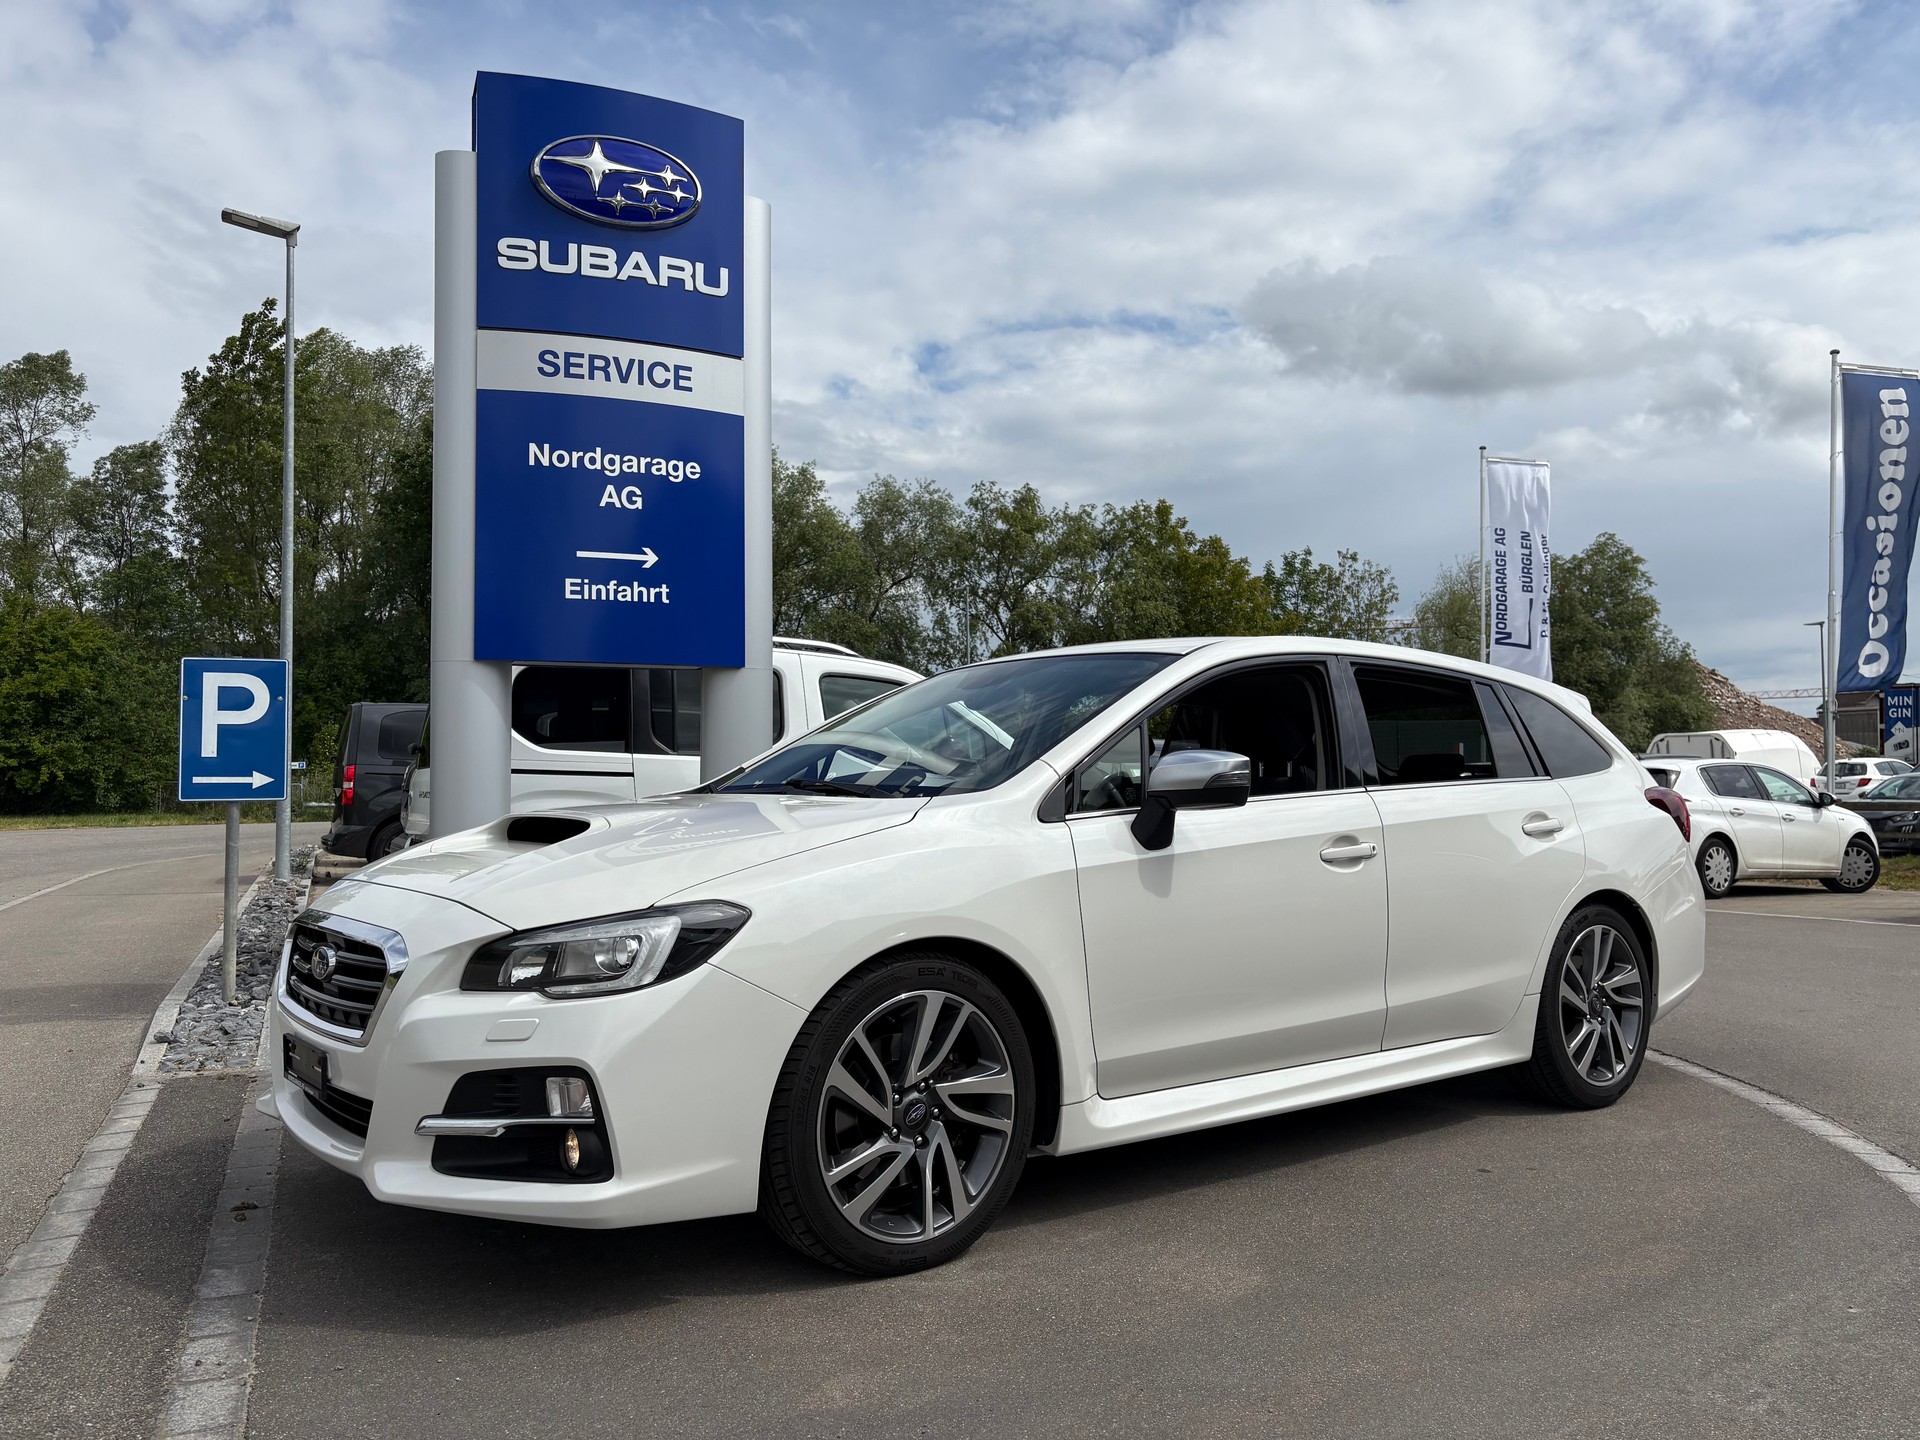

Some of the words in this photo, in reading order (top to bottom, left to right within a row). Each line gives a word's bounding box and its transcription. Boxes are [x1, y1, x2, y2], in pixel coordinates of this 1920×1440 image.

[497, 237, 729, 297] SUBARU
[537, 350, 694, 393] SERVICE
[528, 442, 701, 483] Nordgarage
[599, 484, 643, 510] AG
[1494, 527, 1506, 546] AG
[1858, 387, 1909, 678] Occasionen
[1518, 531, 1533, 593] BÜRGLEN
[565, 578, 670, 604] Einfahrt
[201, 672, 270, 758] P
[1887, 695, 1913, 706] MIN
[1888, 707, 1912, 718] GIN
